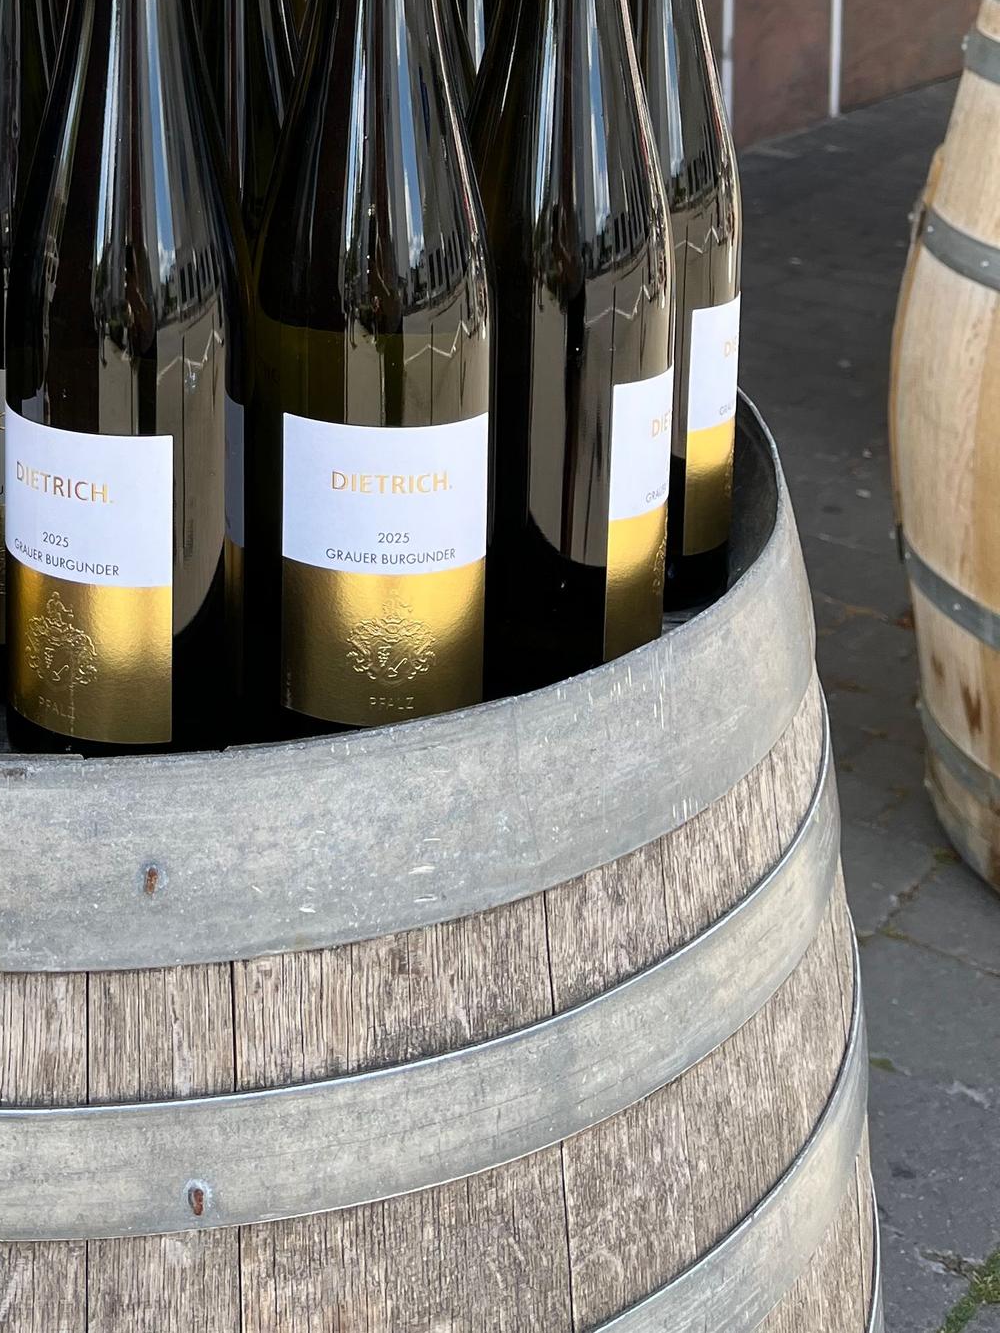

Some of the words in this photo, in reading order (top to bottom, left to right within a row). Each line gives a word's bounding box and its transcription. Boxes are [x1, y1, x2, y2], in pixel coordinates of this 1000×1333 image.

[16, 460, 114, 503] DIETRICH.
[331, 470, 453, 495] DIETRICH.
[42, 531, 70, 548] 2025
[377, 532, 410, 544] 2025
[14, 538, 43, 563] GRAUER
[45, 554, 120, 577] BURGUNDER
[325, 548, 378, 565] GRAUER
[381, 548, 456, 565] BURGUNDER
[369, 697, 415, 711] PFALZ
